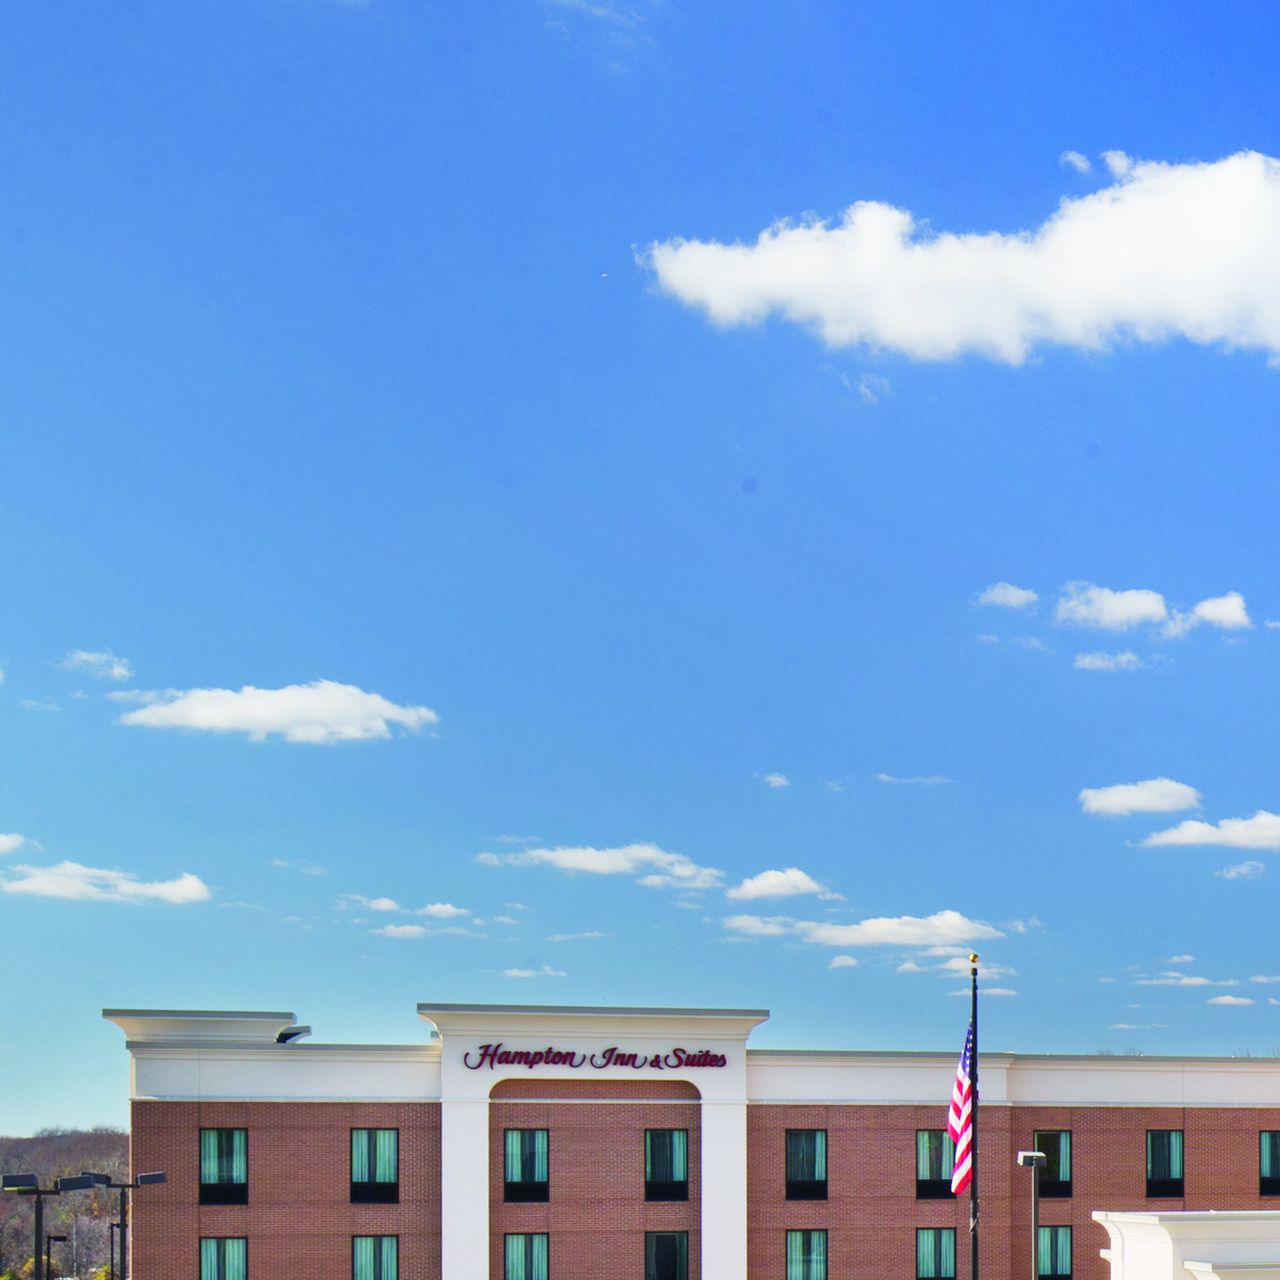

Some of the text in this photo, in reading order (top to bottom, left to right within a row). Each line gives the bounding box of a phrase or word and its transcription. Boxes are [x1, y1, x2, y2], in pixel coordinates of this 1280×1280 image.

[463, 1043, 727, 1070] Hampton Inn & Suites
